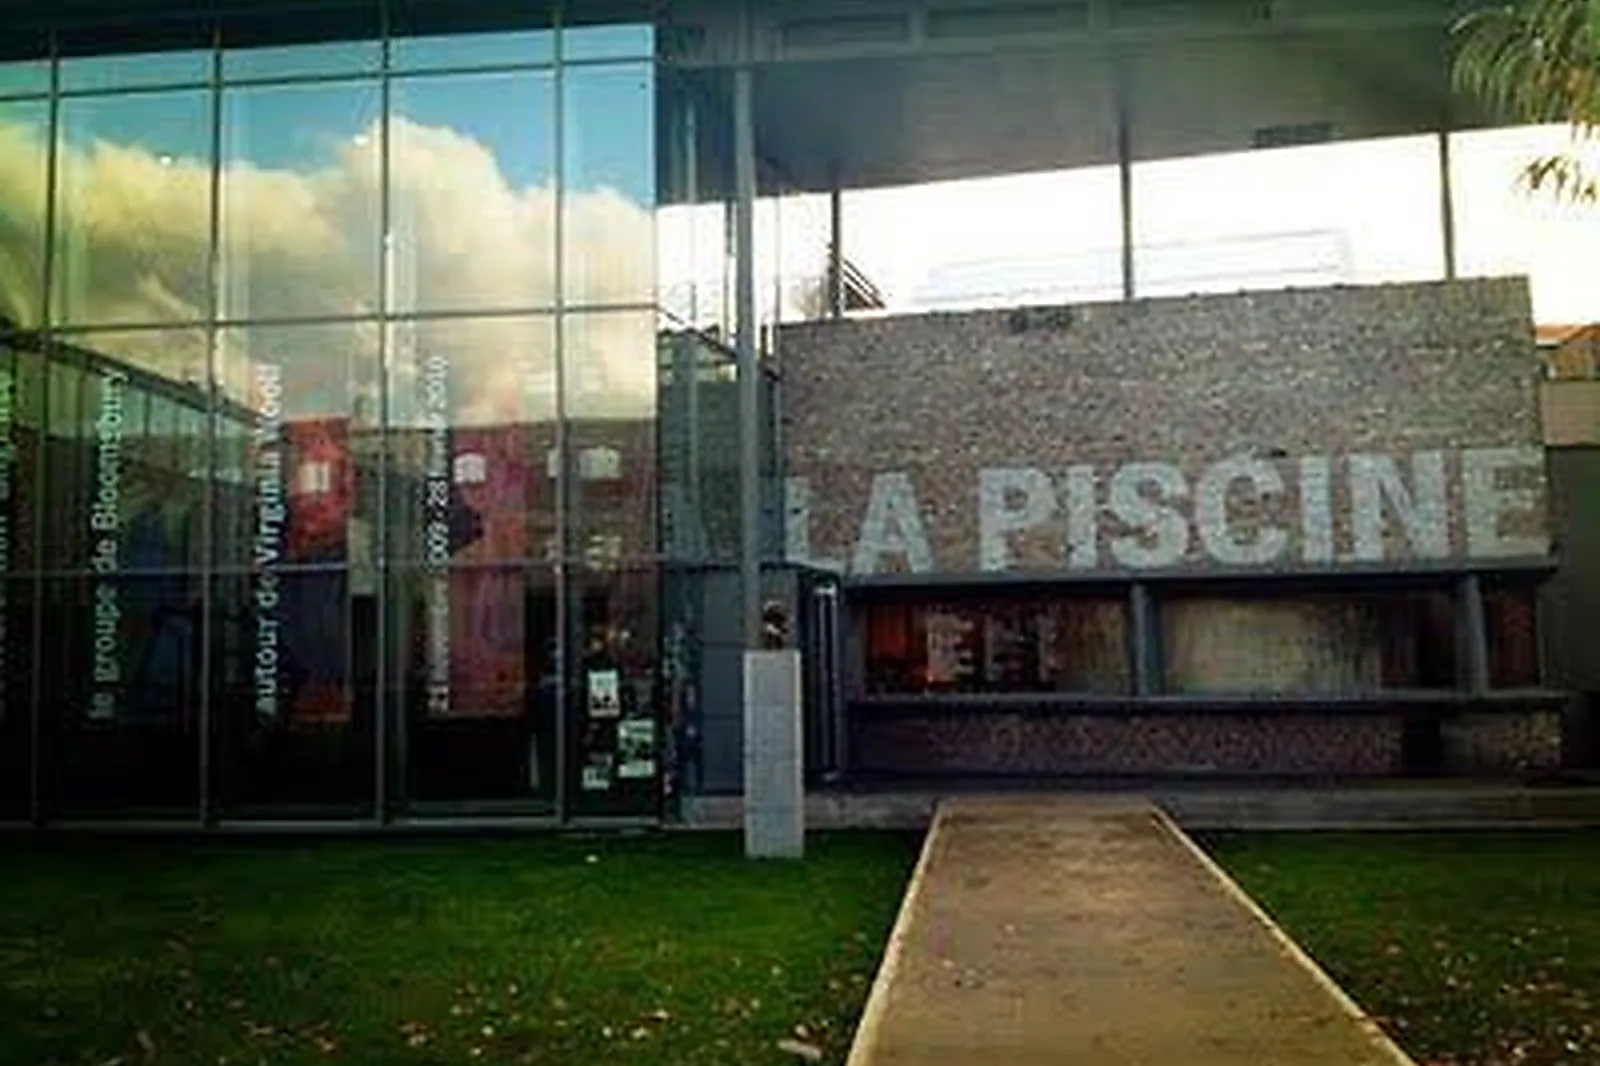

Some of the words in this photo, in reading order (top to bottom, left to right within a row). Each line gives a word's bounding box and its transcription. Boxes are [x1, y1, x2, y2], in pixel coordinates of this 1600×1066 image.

[91, 368, 129, 531] Bloomsbury
[91, 540, 117, 574] de
[254, 452, 284, 564] Virginia
[784, 471, 934, 576] LA
[977, 446, 1551, 573] PISCINE
[94, 584, 120, 683] groupe
[254, 575, 279, 608] de
[88, 692, 115, 720] le
[254, 616, 279, 716] autour
